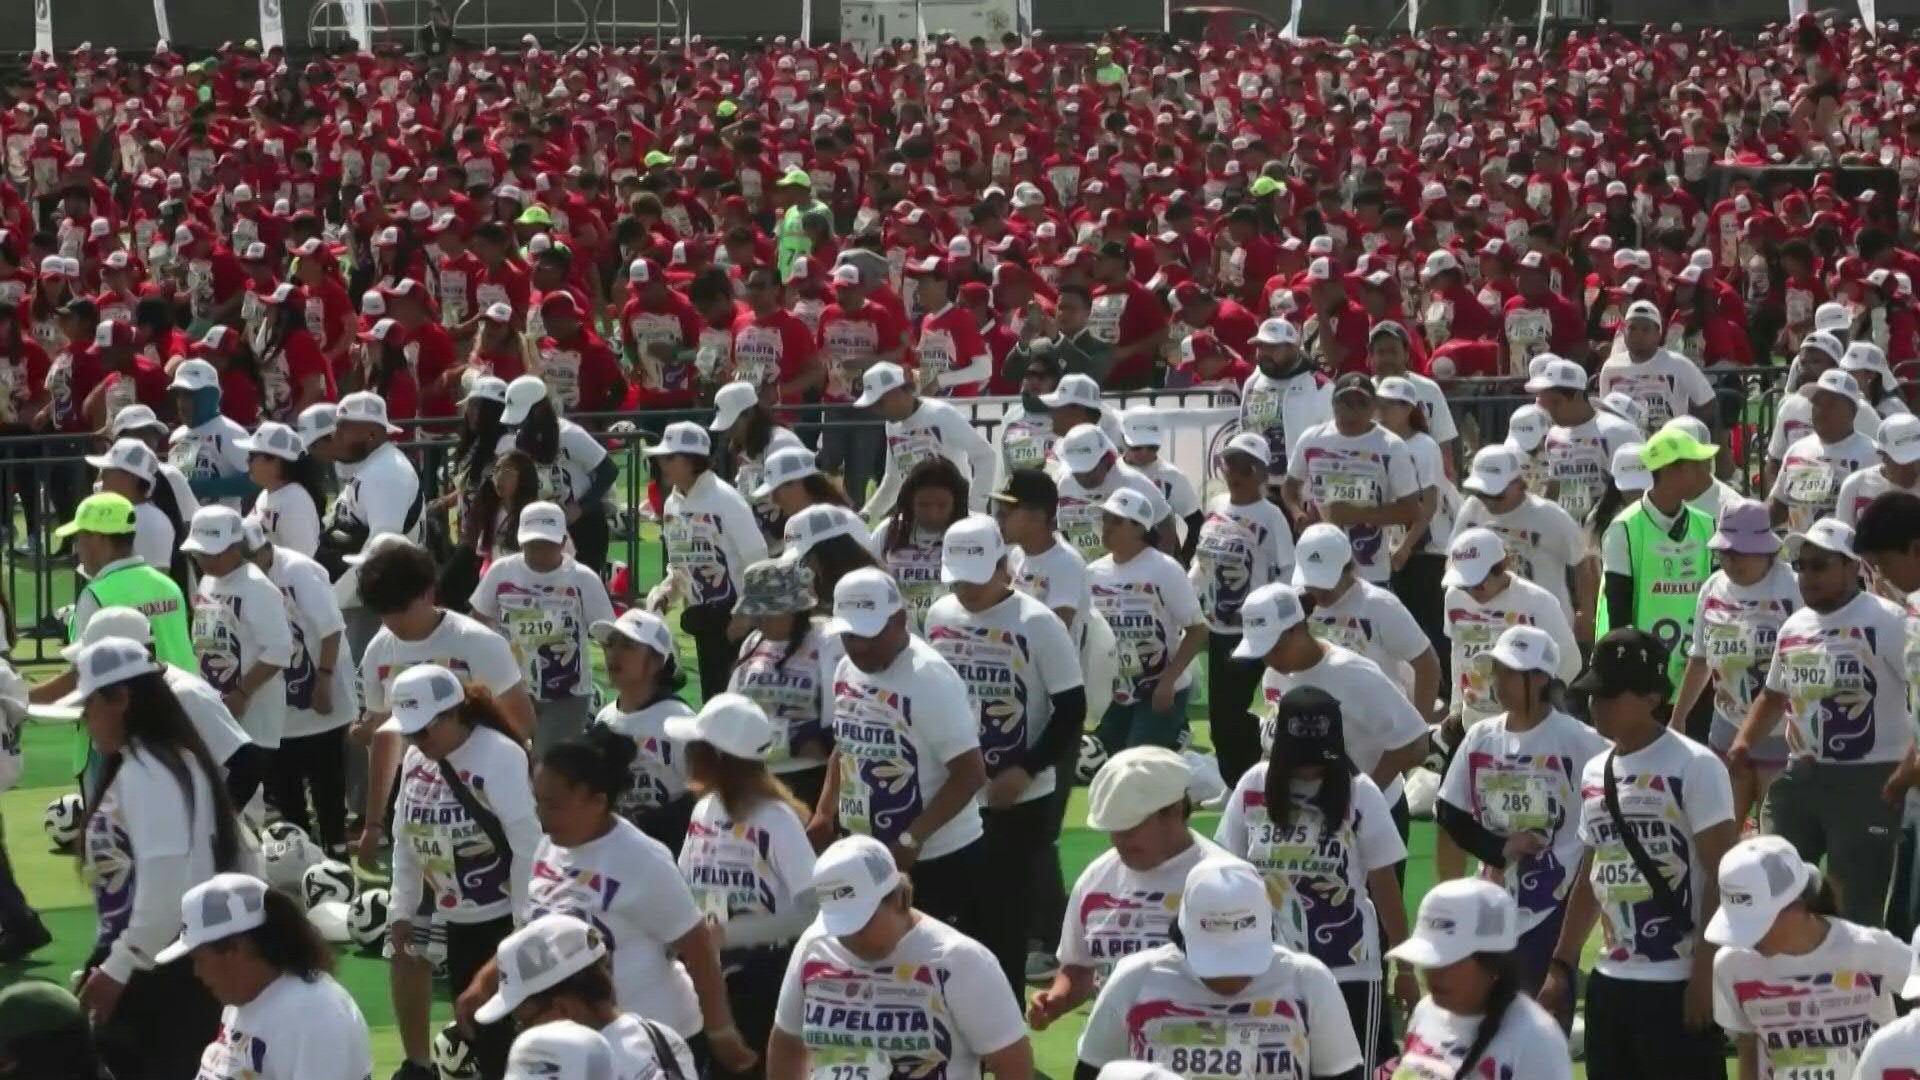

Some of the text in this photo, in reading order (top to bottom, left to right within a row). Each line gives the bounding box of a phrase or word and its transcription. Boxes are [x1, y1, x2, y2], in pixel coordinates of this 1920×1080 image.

[1652, 582, 1703, 594] AUXILI
[520, 620, 553, 635] 2219
[1792, 668, 1825, 684] 3902
[841, 722, 896, 745] PELOTA
[1502, 792, 1531, 812] 289
[411, 805, 467, 824] PELOT
[1261, 824, 1308, 844] 3875
[1595, 863, 1641, 884] 4052
[828, 1007, 929, 1033] PELOTA
[805, 1030, 856, 1048] UELVE
[877, 1036, 931, 1050] CASA
[1786, 1019, 1871, 1050] PELOTA
[1172, 1047, 1242, 1075] 8828
